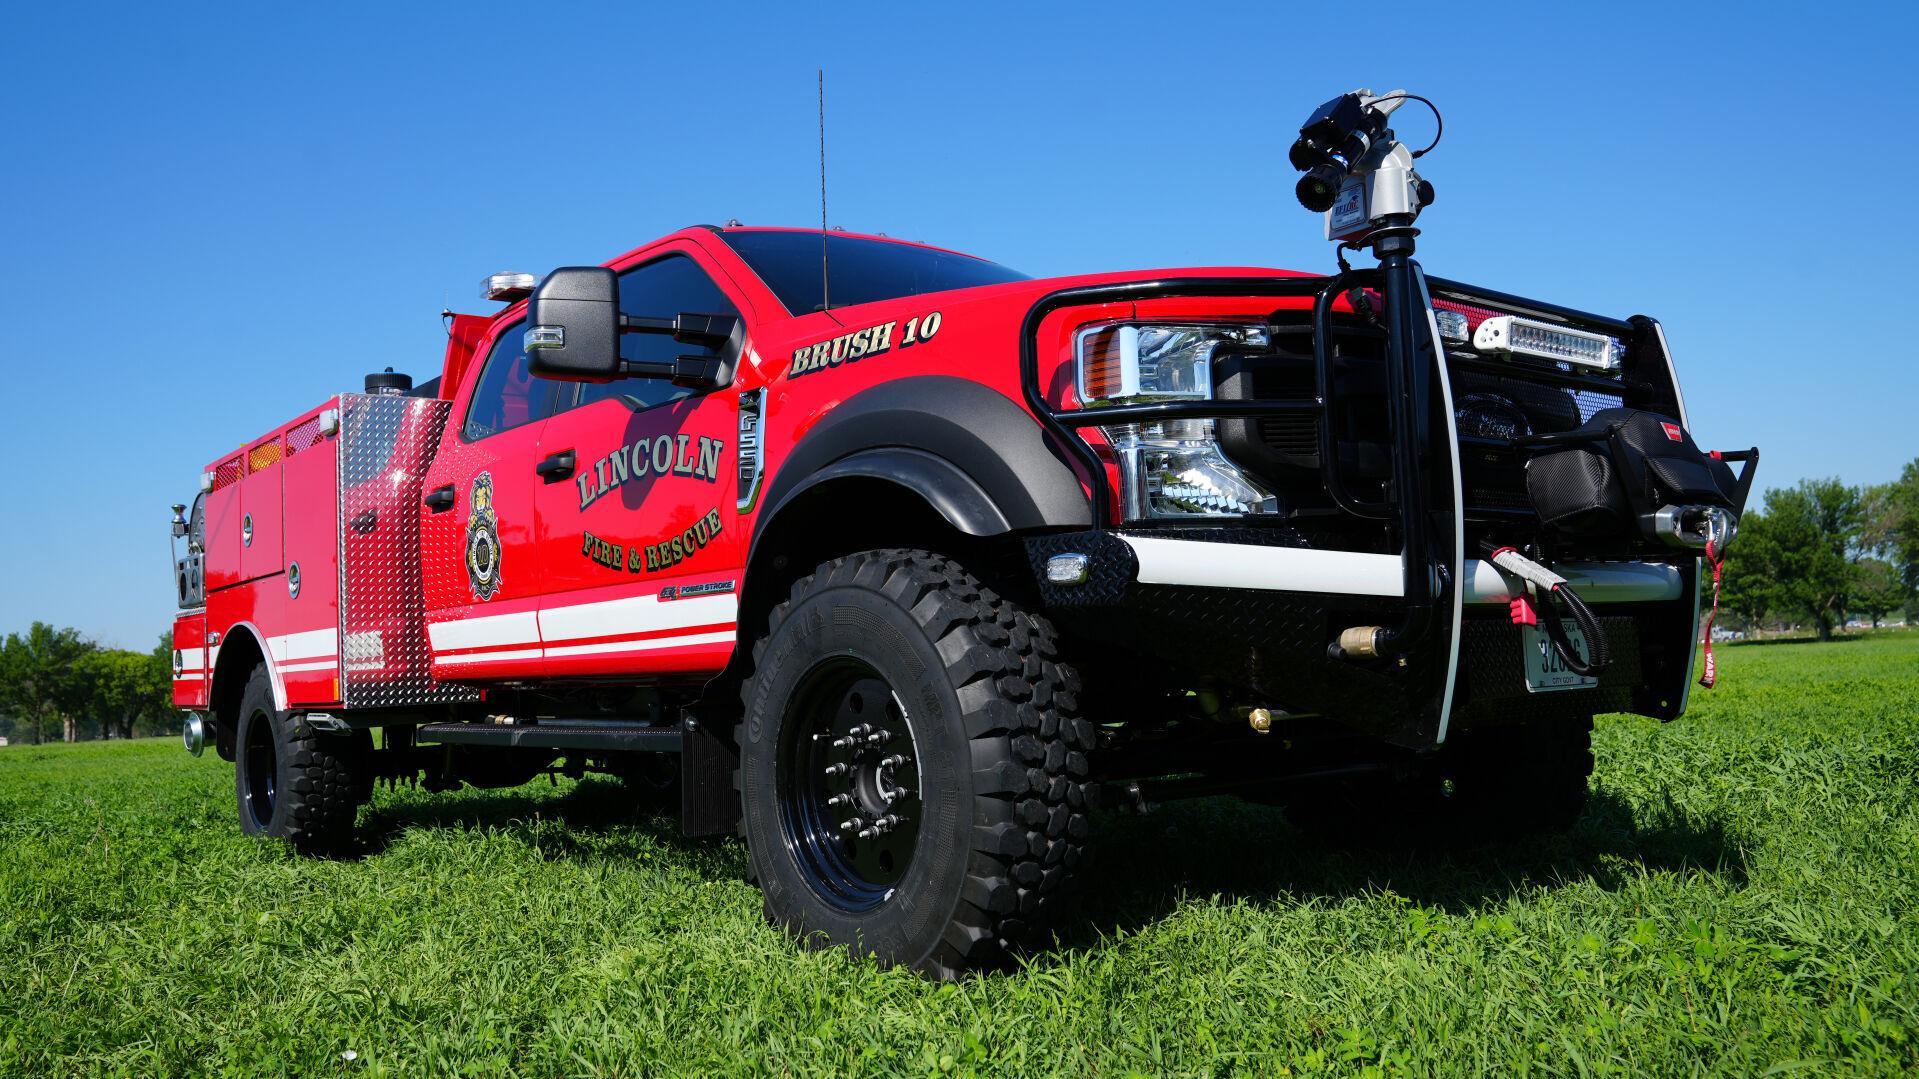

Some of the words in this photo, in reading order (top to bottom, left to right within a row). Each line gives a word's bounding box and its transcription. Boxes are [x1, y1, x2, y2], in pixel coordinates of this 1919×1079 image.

[787, 320, 897, 380] BRUSH
[899, 311, 942, 349] 10
[576, 434, 724, 512] LINCOLN
[582, 531, 623, 571] FIRE
[628, 547, 642, 573] &
[645, 506, 723, 572] RESCUE
[681, 585, 703, 594] POWER
[704, 581, 732, 591] STROKE
